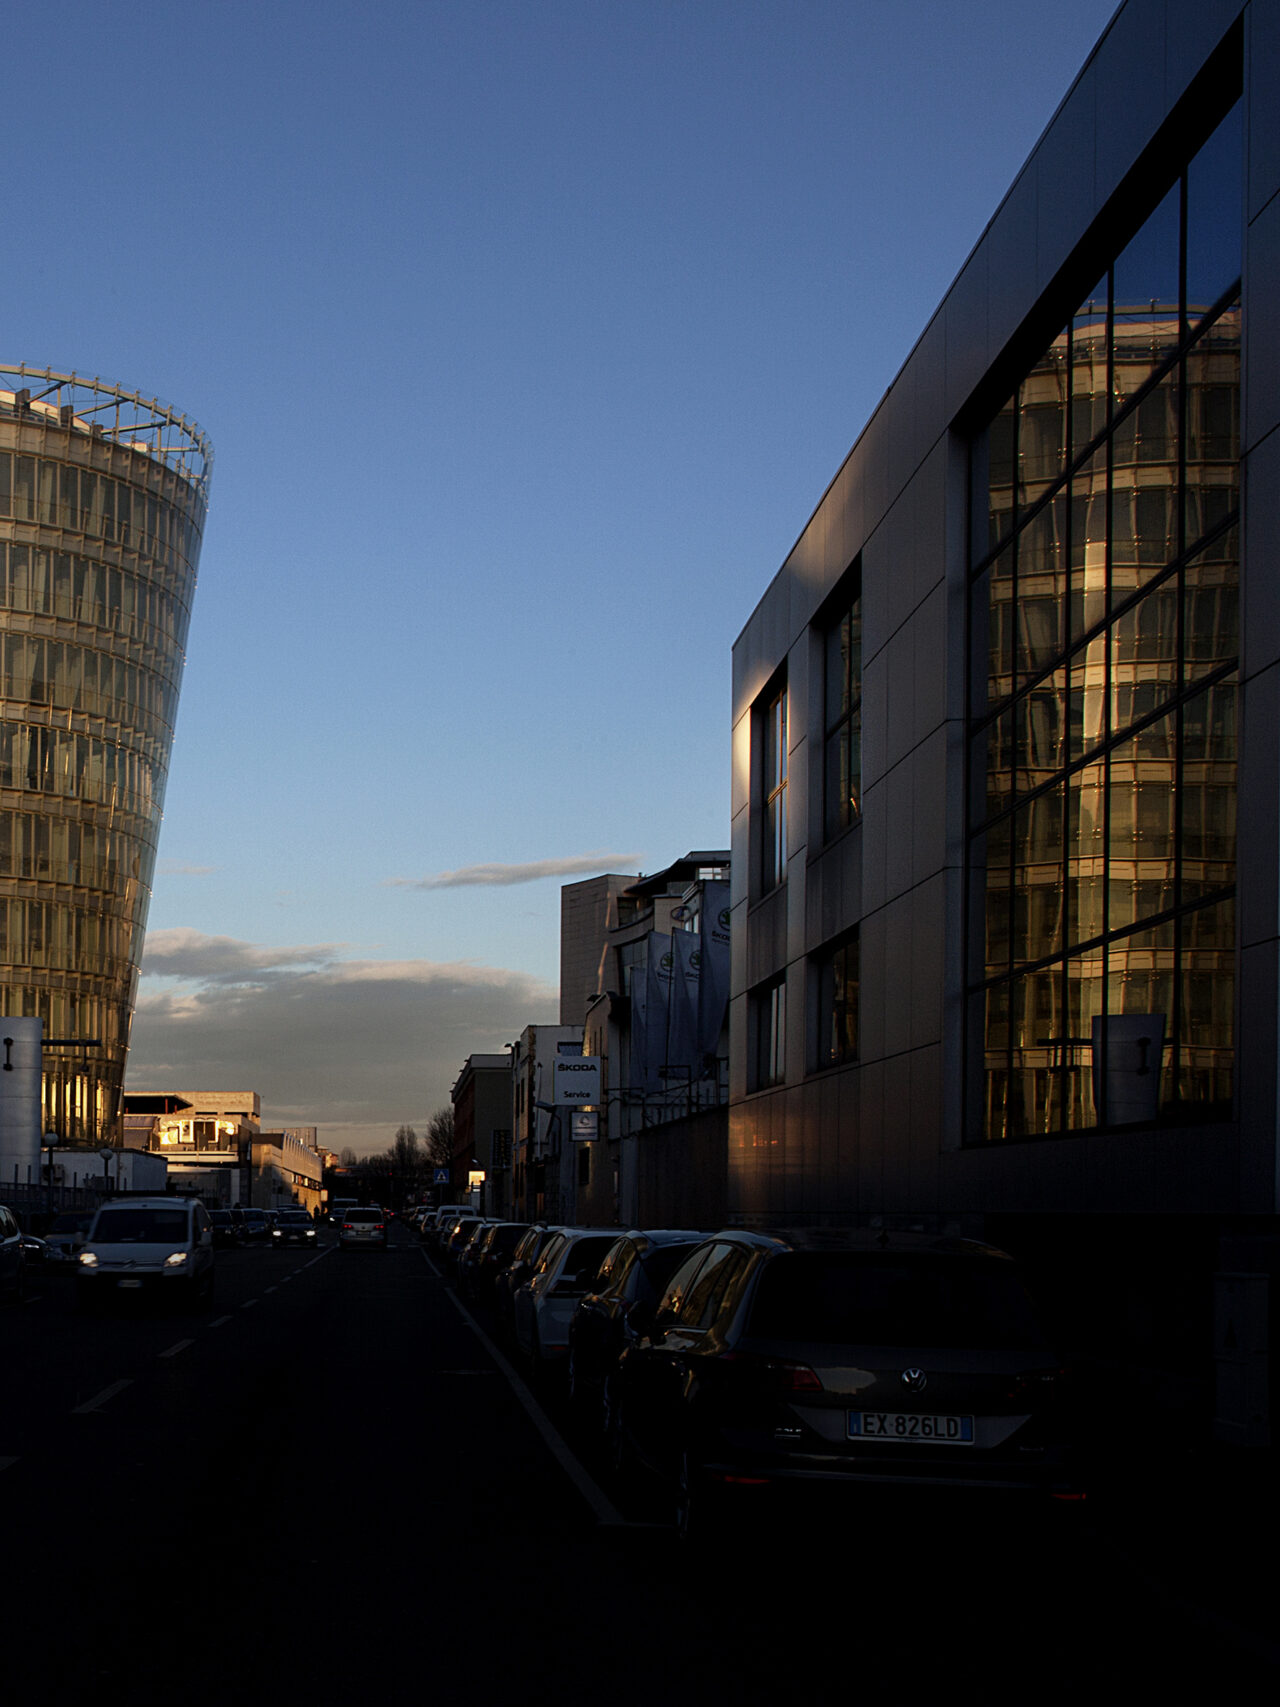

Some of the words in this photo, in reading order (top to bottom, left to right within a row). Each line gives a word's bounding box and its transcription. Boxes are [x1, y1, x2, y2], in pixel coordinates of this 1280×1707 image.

[558, 1063, 597, 1072] ŠKODA
[563, 1090, 591, 1098] Service
[863, 1414, 887, 1434] EX
[895, 1416, 958, 1438] 826LD
